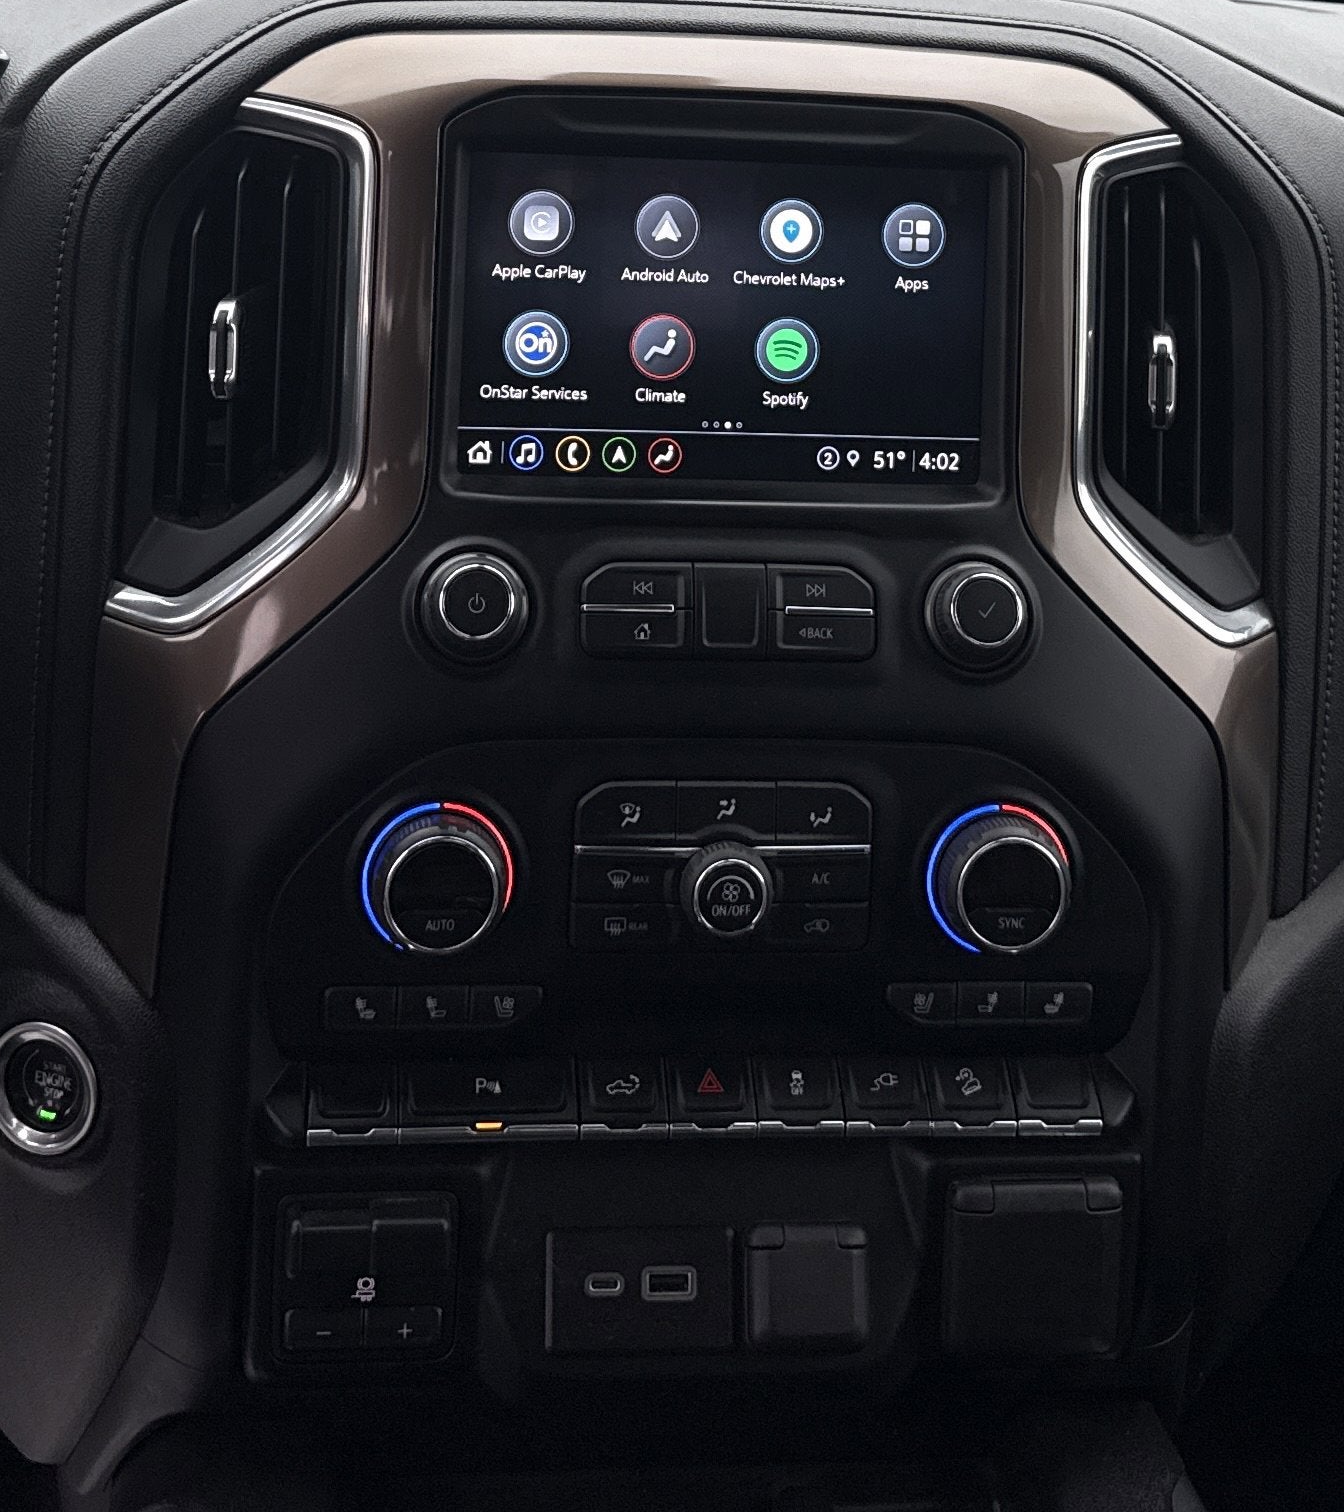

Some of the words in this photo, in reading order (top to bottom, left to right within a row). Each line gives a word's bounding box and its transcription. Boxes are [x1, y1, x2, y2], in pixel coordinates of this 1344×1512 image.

[492, 264, 531, 280] Apple
[535, 265, 587, 283] CarPlay
[621, 267, 674, 283] Android
[677, 269, 709, 284] Auto
[733, 271, 797, 287] Chevrolet
[800, 273, 846, 290] Maps+
[895, 277, 929, 293] Apps
[519, 332, 553, 353] On
[479, 385, 529, 400] OnStar
[531, 386, 588, 402] Services
[635, 388, 686, 403] Climate
[762, 392, 809, 411] Spotify
[823, 452, 833, 465] 2
[873, 450, 906, 469] 51°
[919, 452, 959, 471] 4:02
[807, 626, 834, 640] BACK
[812, 872, 832, 885] A/C
[711, 903, 751, 918] ON/OFF
[425, 918, 455, 931] AUTO
[998, 916, 1026, 930] SYNC
[34, 1070, 73, 1091] ENGINE
